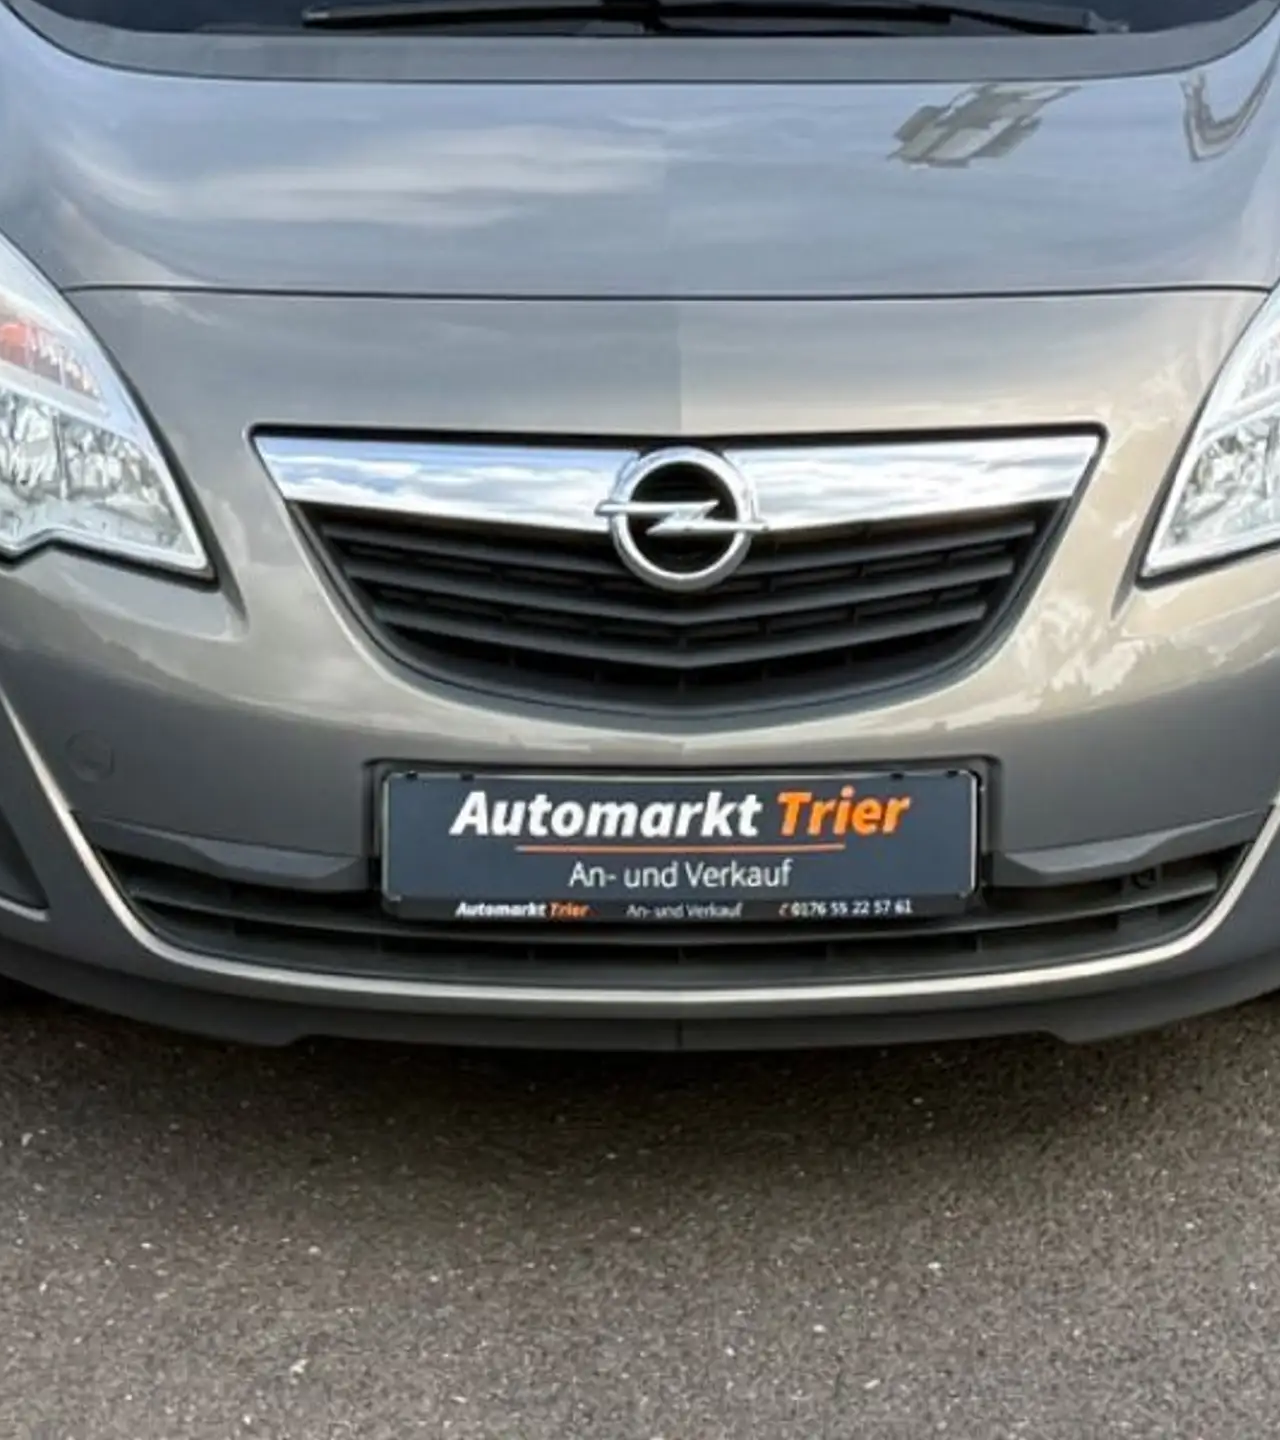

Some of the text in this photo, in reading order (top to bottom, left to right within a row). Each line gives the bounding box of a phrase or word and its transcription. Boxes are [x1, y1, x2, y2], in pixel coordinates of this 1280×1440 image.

[448, 785, 911, 838] Automarkt Trier
[568, 859, 793, 889] An- und Verkauf
[455, 901, 589, 919] Automarkt Trier
